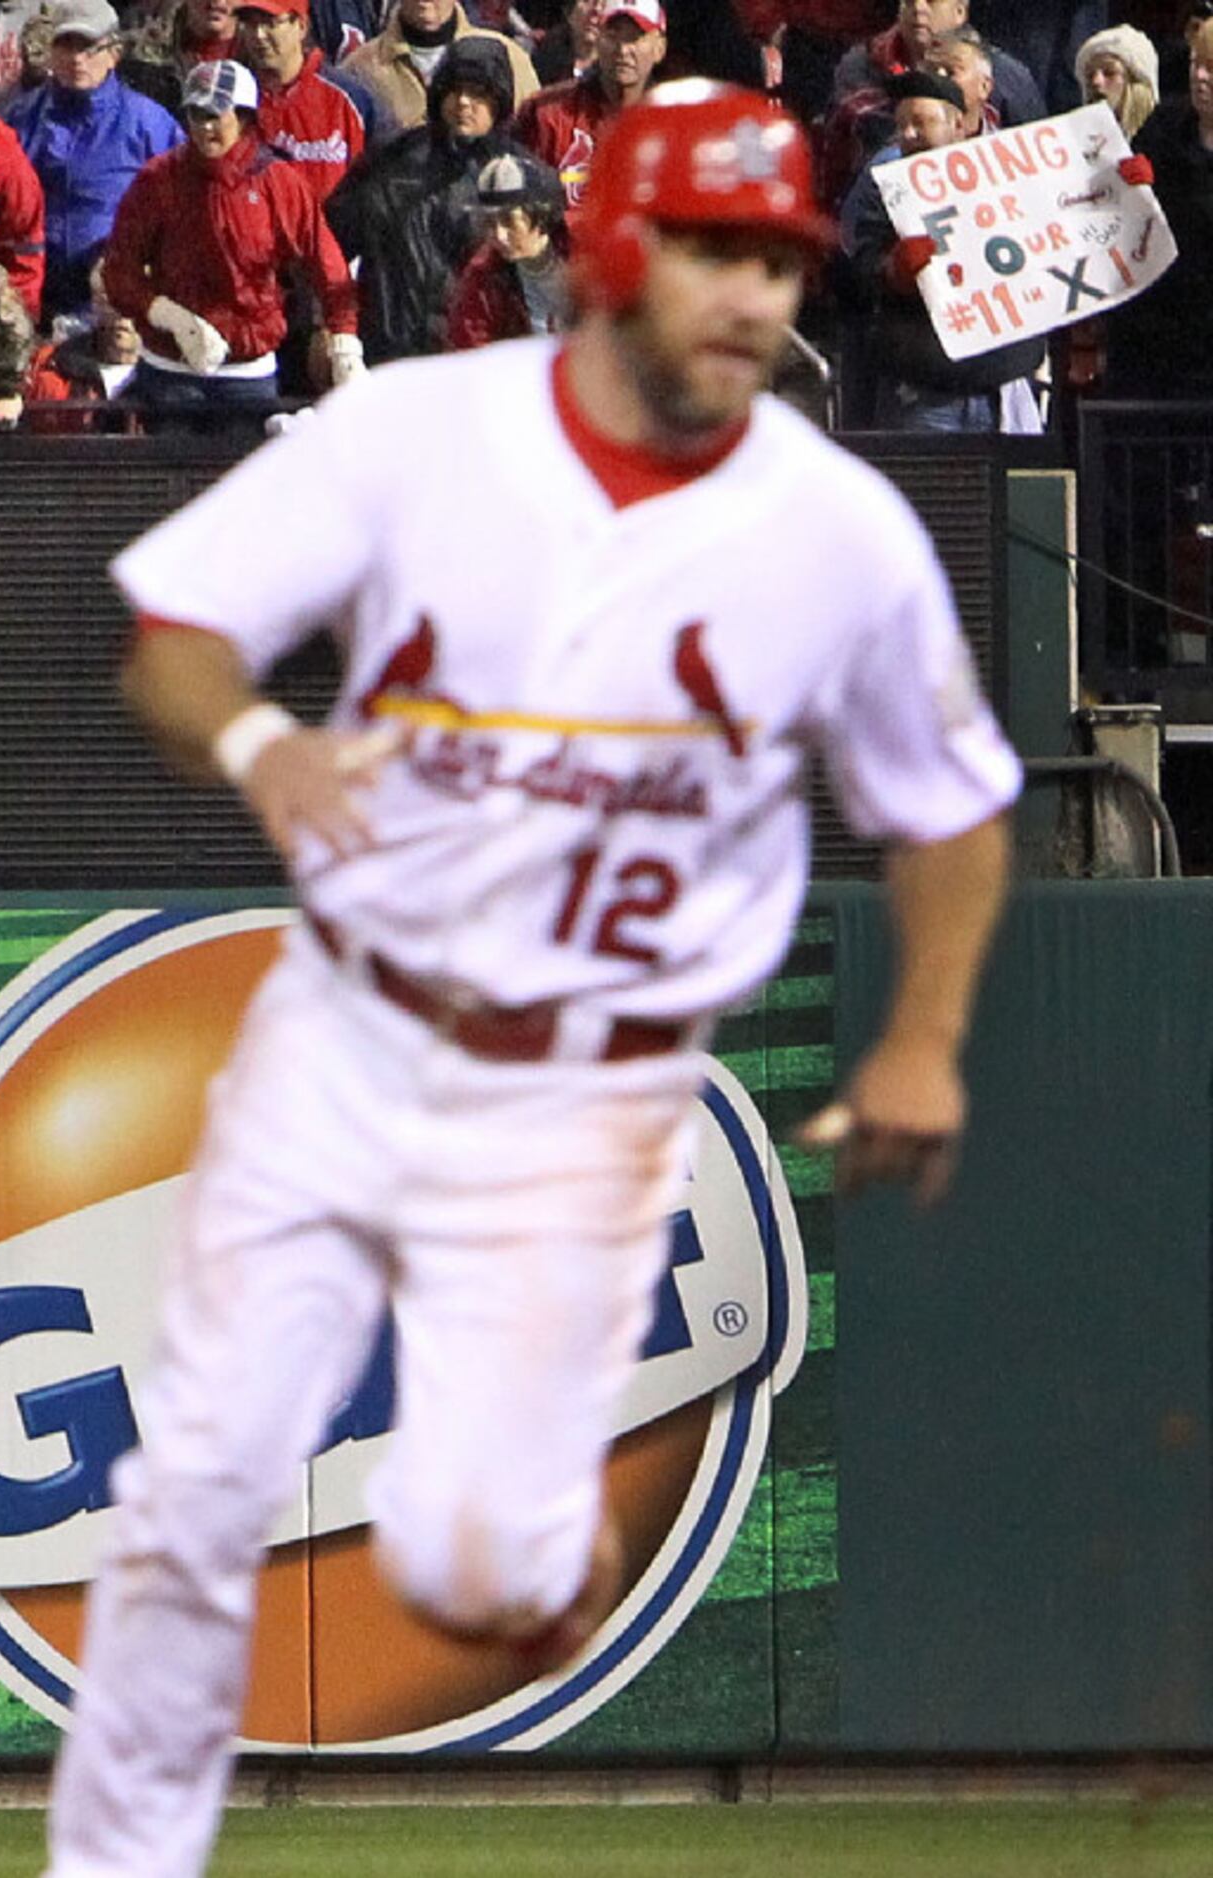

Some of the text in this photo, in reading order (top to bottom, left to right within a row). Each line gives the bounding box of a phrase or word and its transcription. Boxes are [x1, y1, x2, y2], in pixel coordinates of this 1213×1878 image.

[908, 126, 1070, 203] GOING
[943, 282, 1024, 336] #11
[550, 841, 684, 967] 12
